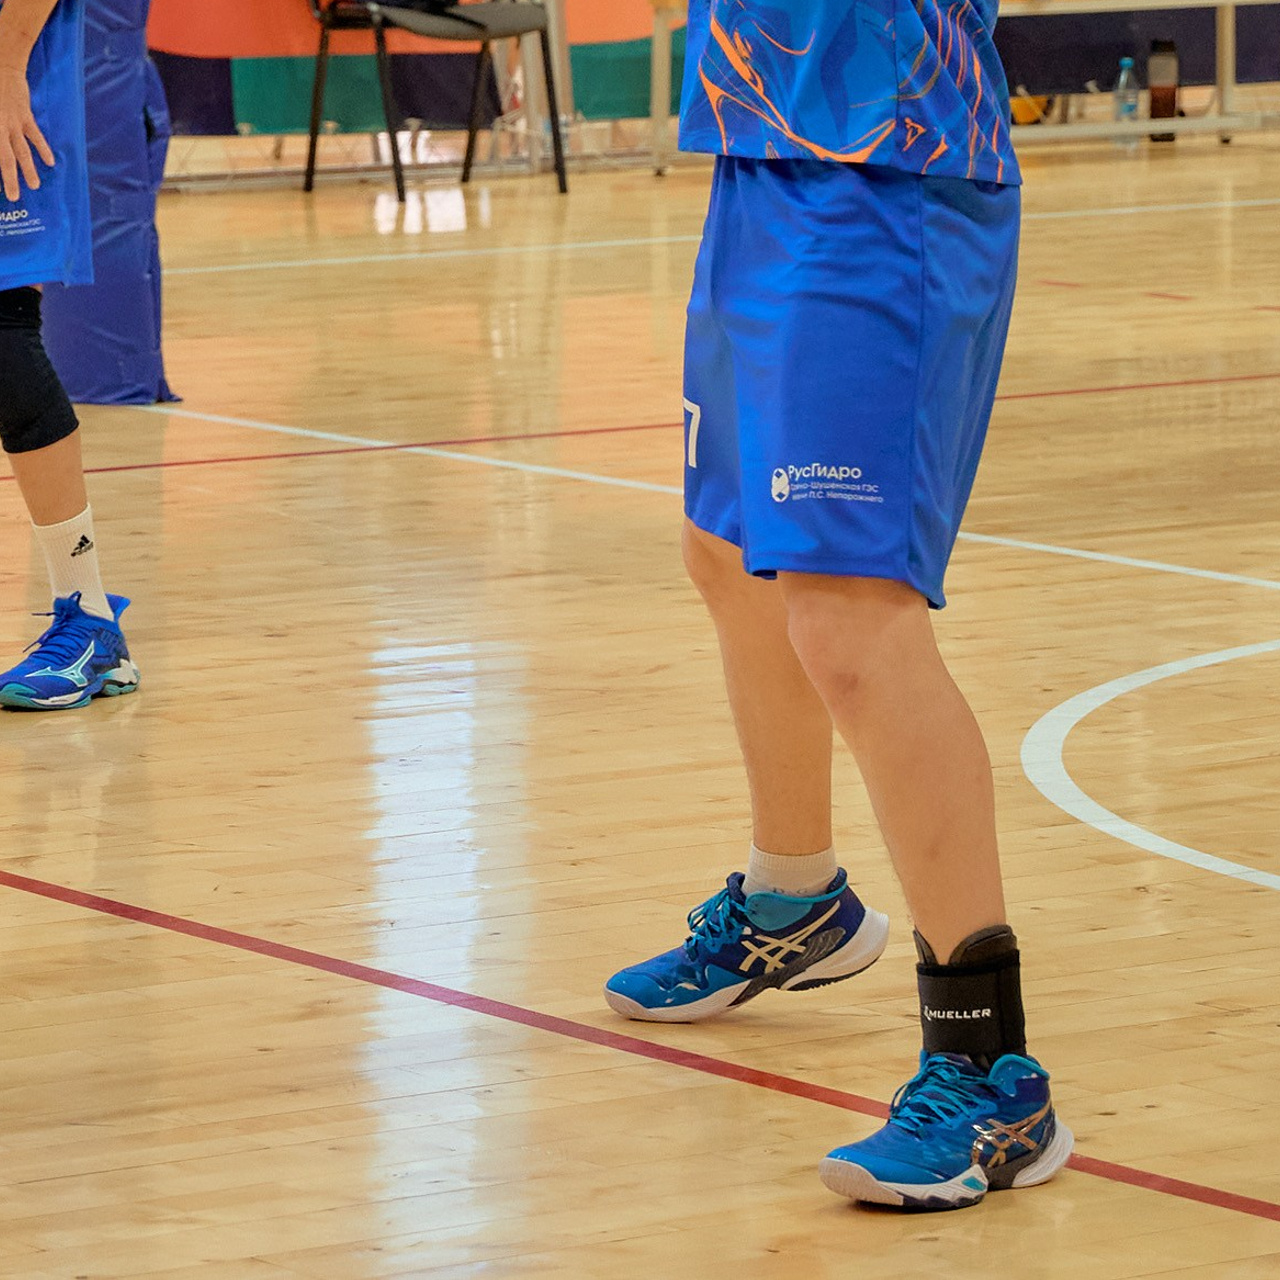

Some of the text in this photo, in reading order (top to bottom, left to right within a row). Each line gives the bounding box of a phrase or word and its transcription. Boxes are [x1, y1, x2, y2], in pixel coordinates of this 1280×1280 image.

[788, 463, 862, 481] РусГидро
[861, 484, 880, 493] ГЭС
[928, 1008, 992, 1020] MUELLER
